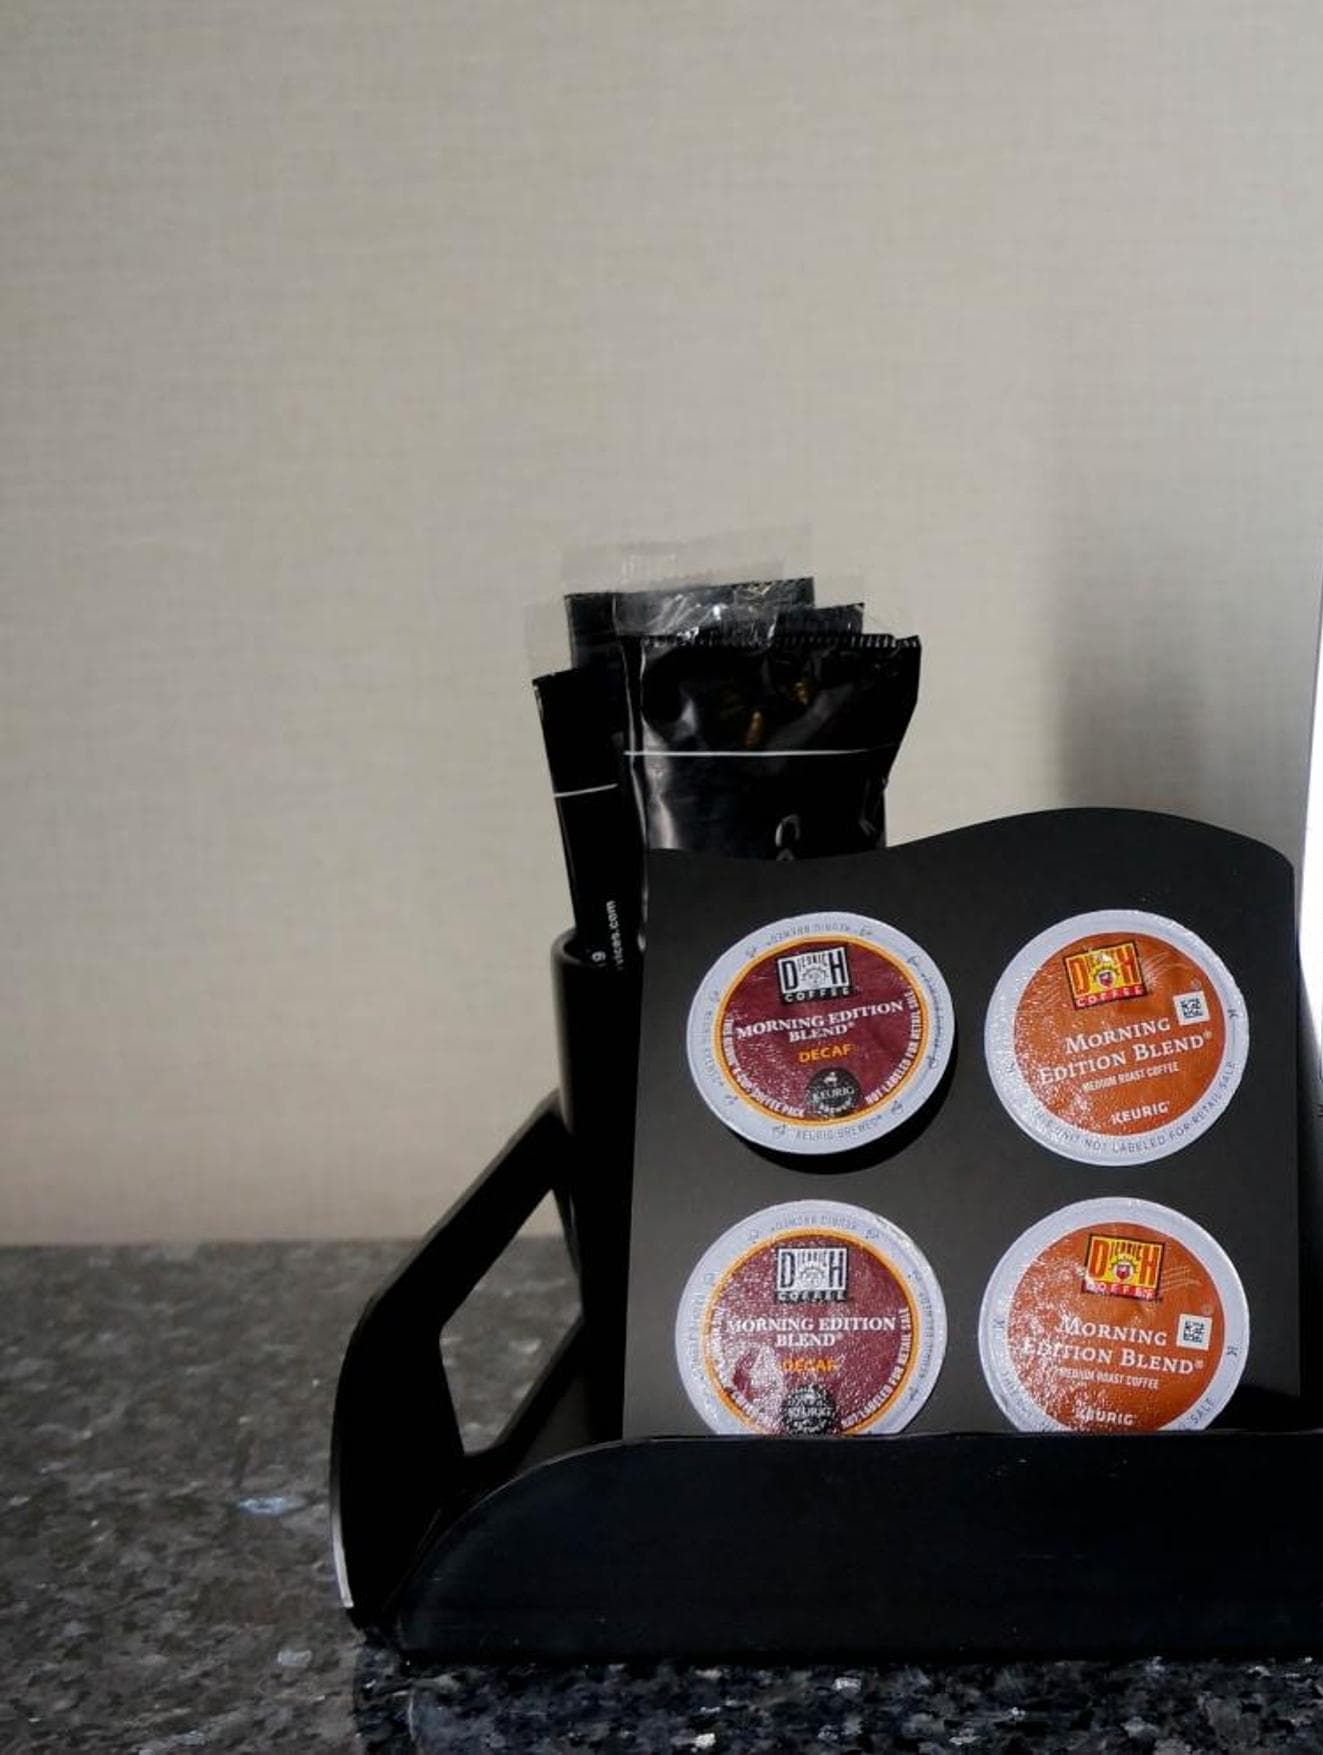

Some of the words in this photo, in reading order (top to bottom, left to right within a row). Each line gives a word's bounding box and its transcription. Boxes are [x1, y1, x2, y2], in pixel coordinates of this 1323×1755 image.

[784, 987, 849, 1003] COFFEE
[736, 1015, 824, 1040] MORNING
[828, 1000, 904, 1025] EDITION
[908, 1010, 921, 1039] RETAIL
[798, 1043, 852, 1063] DECAF
[903, 1040, 919, 1058] FOR
[1081, 1075, 1118, 1093] MEDIUM
[1119, 1069, 1147, 1085] ROAST
[1148, 1061, 1180, 1078] COFFEE
[812, 1086, 855, 1102] KEURIG
[864, 1089, 884, 1106] NOT
[780, 1103, 805, 1117] PACK
[1111, 1101, 1169, 1125] KEURIG
[1110, 1136, 1166, 1152] LABELED
[1166, 1121, 1193, 1141] FOR
[1190, 1093, 1222, 1126] RETAIL
[727, 1317, 814, 1332] MORNING
[818, 1316, 896, 1331] EDITION
[897, 1306, 913, 1331] SALE
[895, 1334, 911, 1367] RETAIL
[886, 1365, 903, 1387] FOR
[1096, 1370, 1123, 1384] ROAST
[1126, 1375, 1159, 1390] COFFEE
